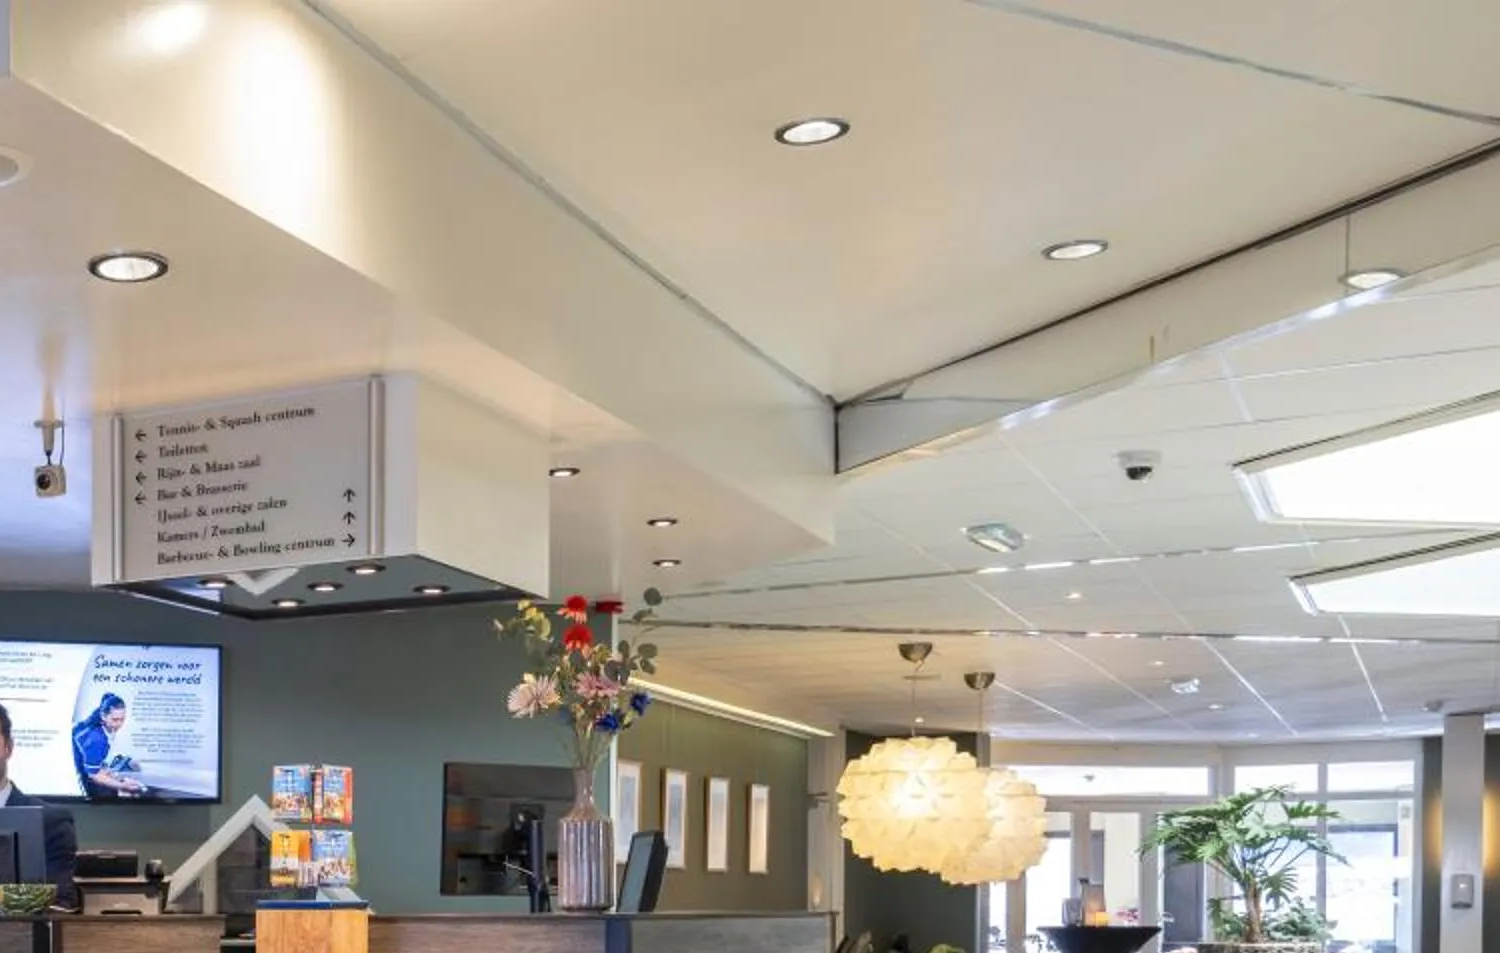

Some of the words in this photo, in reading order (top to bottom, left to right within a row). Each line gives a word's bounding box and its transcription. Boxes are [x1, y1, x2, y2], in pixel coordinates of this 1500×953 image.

[157, 424, 200, 437] Tennis-
[203, 418, 218, 431] &
[219, 411, 261, 429] Squash
[265, 407, 315, 422] centrum
[158, 443, 208, 457] Toiletten
[189, 462, 202, 475] &
[205, 460, 235, 473] Maas
[238, 454, 261, 470] zaal
[157, 488, 178, 501] Bar
[181, 485, 193, 497] &
[196, 480, 249, 496] Brasserie
[195, 504, 208, 517] &
[211, 501, 253, 515] overige
[257, 495, 288, 511] zalen
[157, 531, 199, 543] Kamers
[211, 518, 266, 537] Zwembad
[157, 550, 213, 565] Barbecue-
[216, 545, 230, 559] &
[233, 540, 282, 557] Bowling
[284, 538, 336, 551] centrum
[94, 654, 133, 669] Samen
[135, 660, 173, 673] zorgen
[167, 673, 202, 685] wereld
